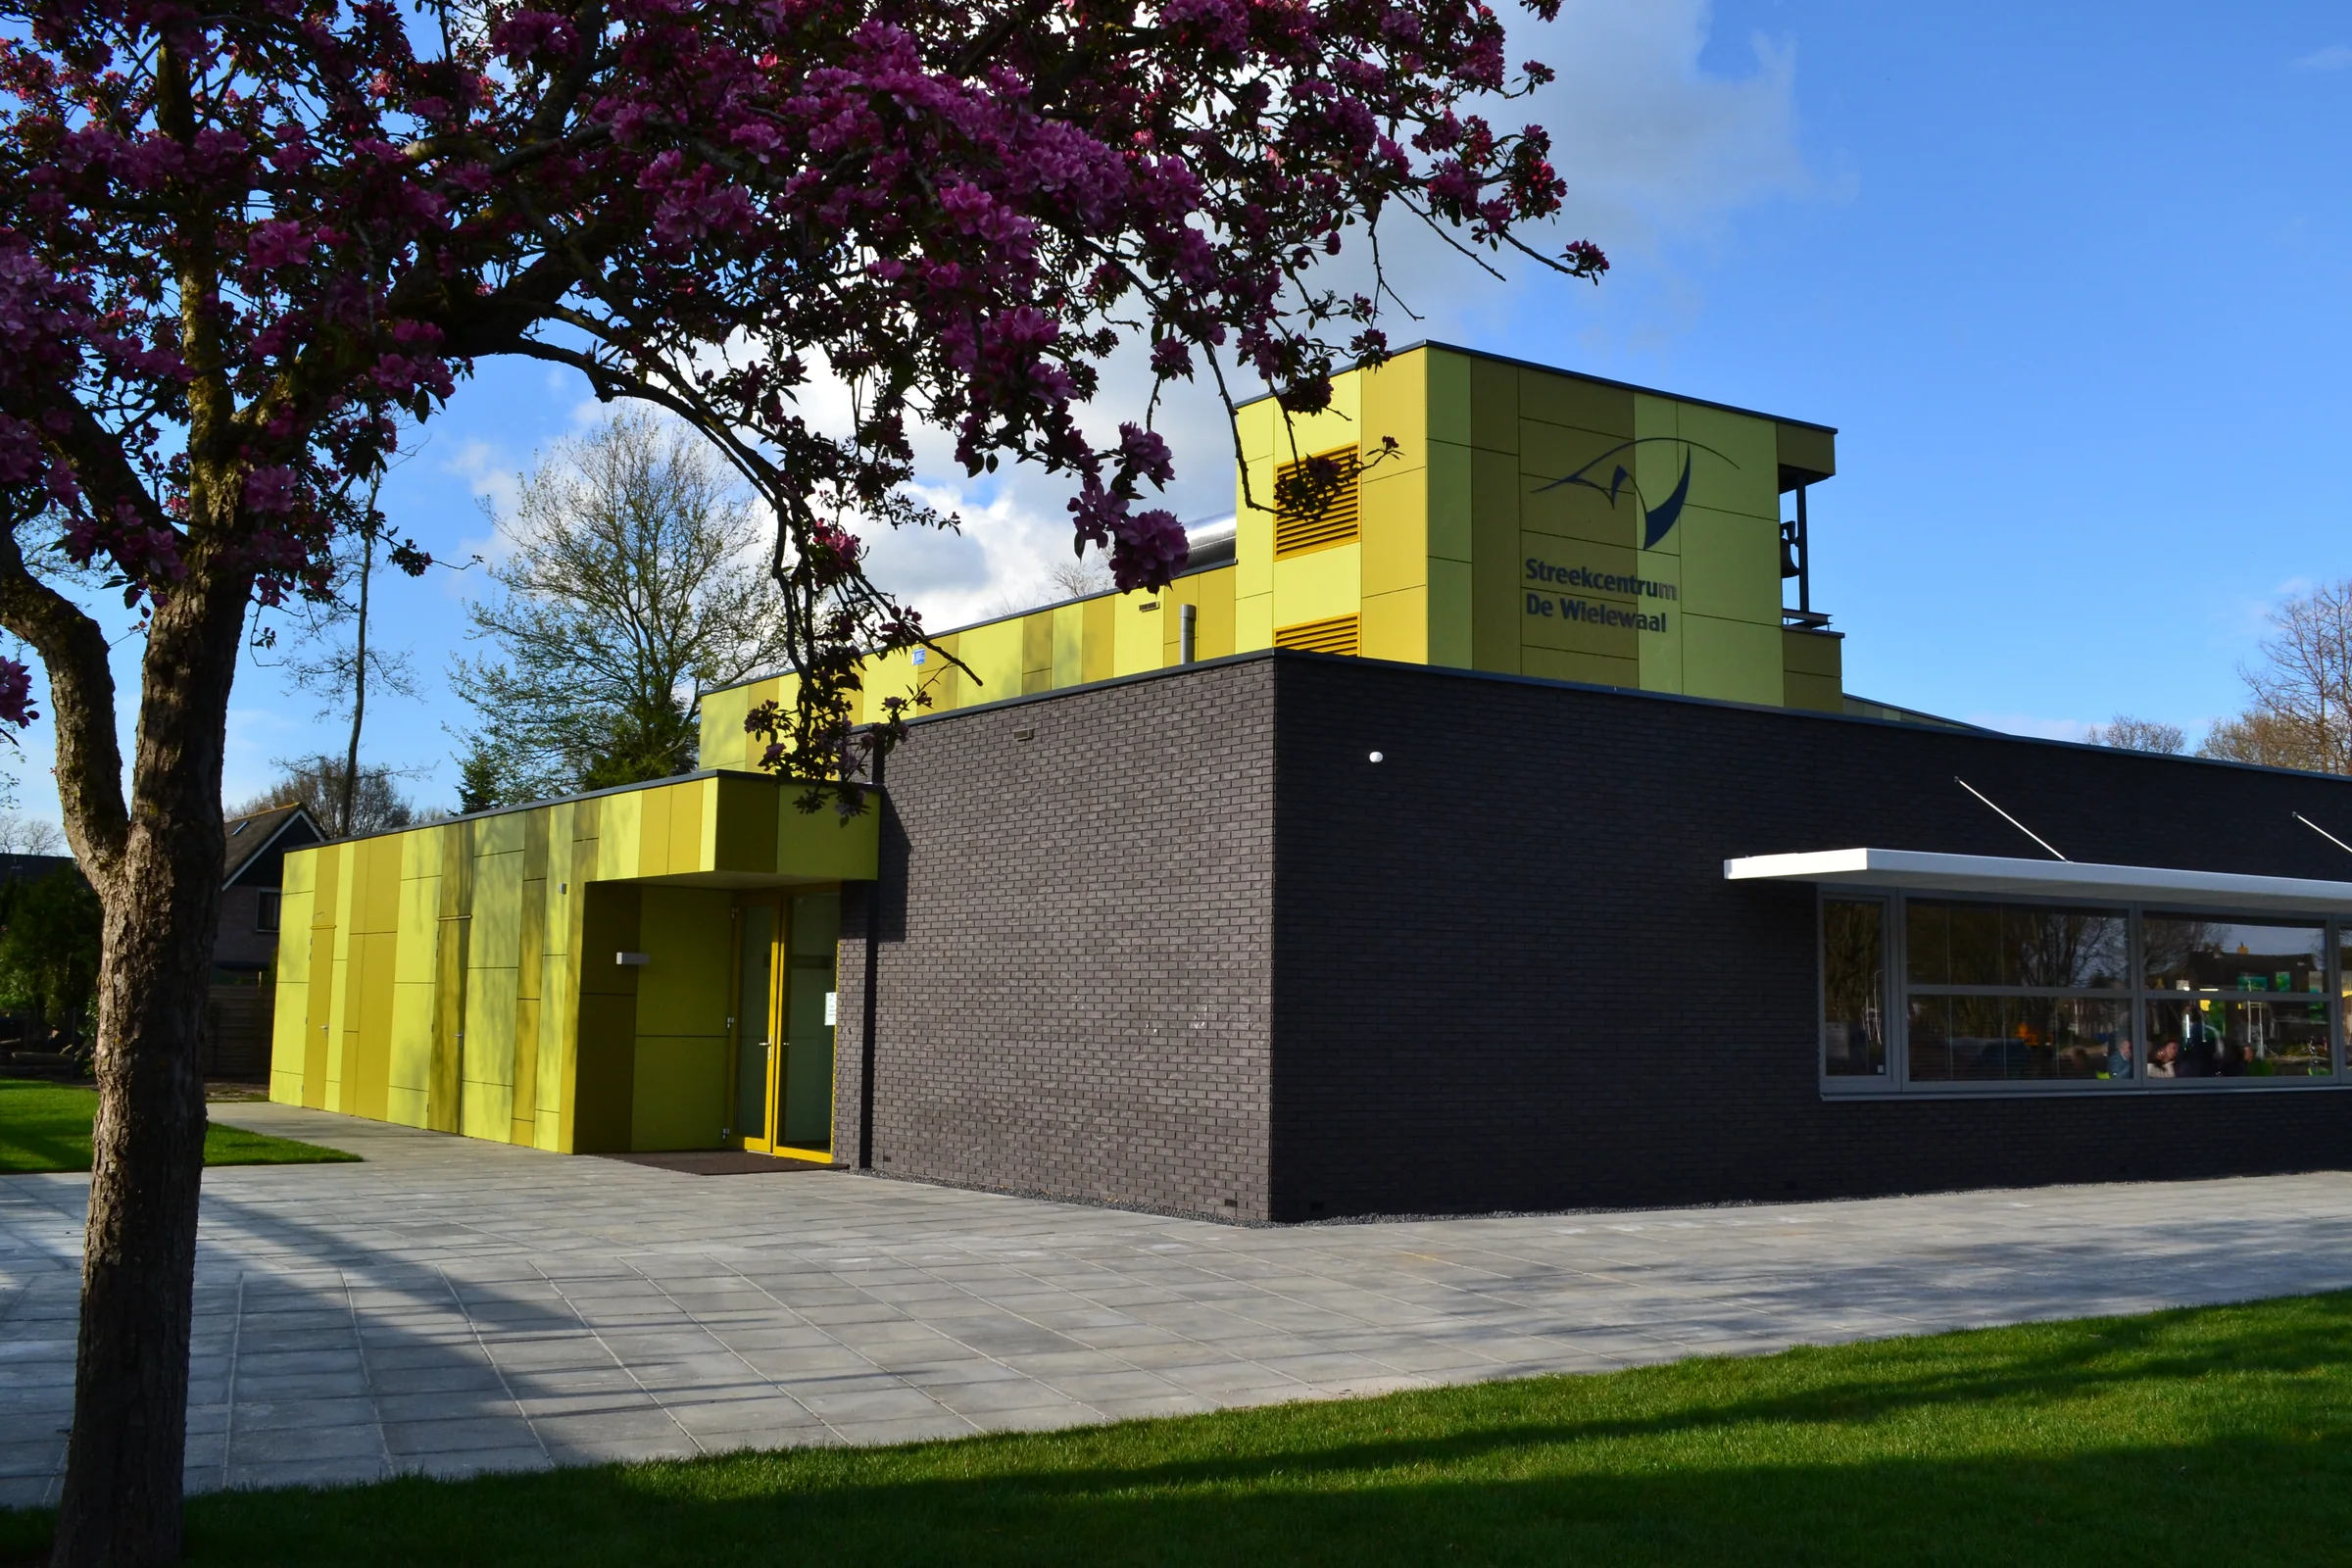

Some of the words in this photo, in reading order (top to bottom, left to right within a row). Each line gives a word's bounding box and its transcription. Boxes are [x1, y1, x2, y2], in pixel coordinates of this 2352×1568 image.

[1525, 559, 1678, 601] Streekcentrum
[1526, 594, 1553, 617] De
[1561, 598, 1667, 632] Wielewaal
